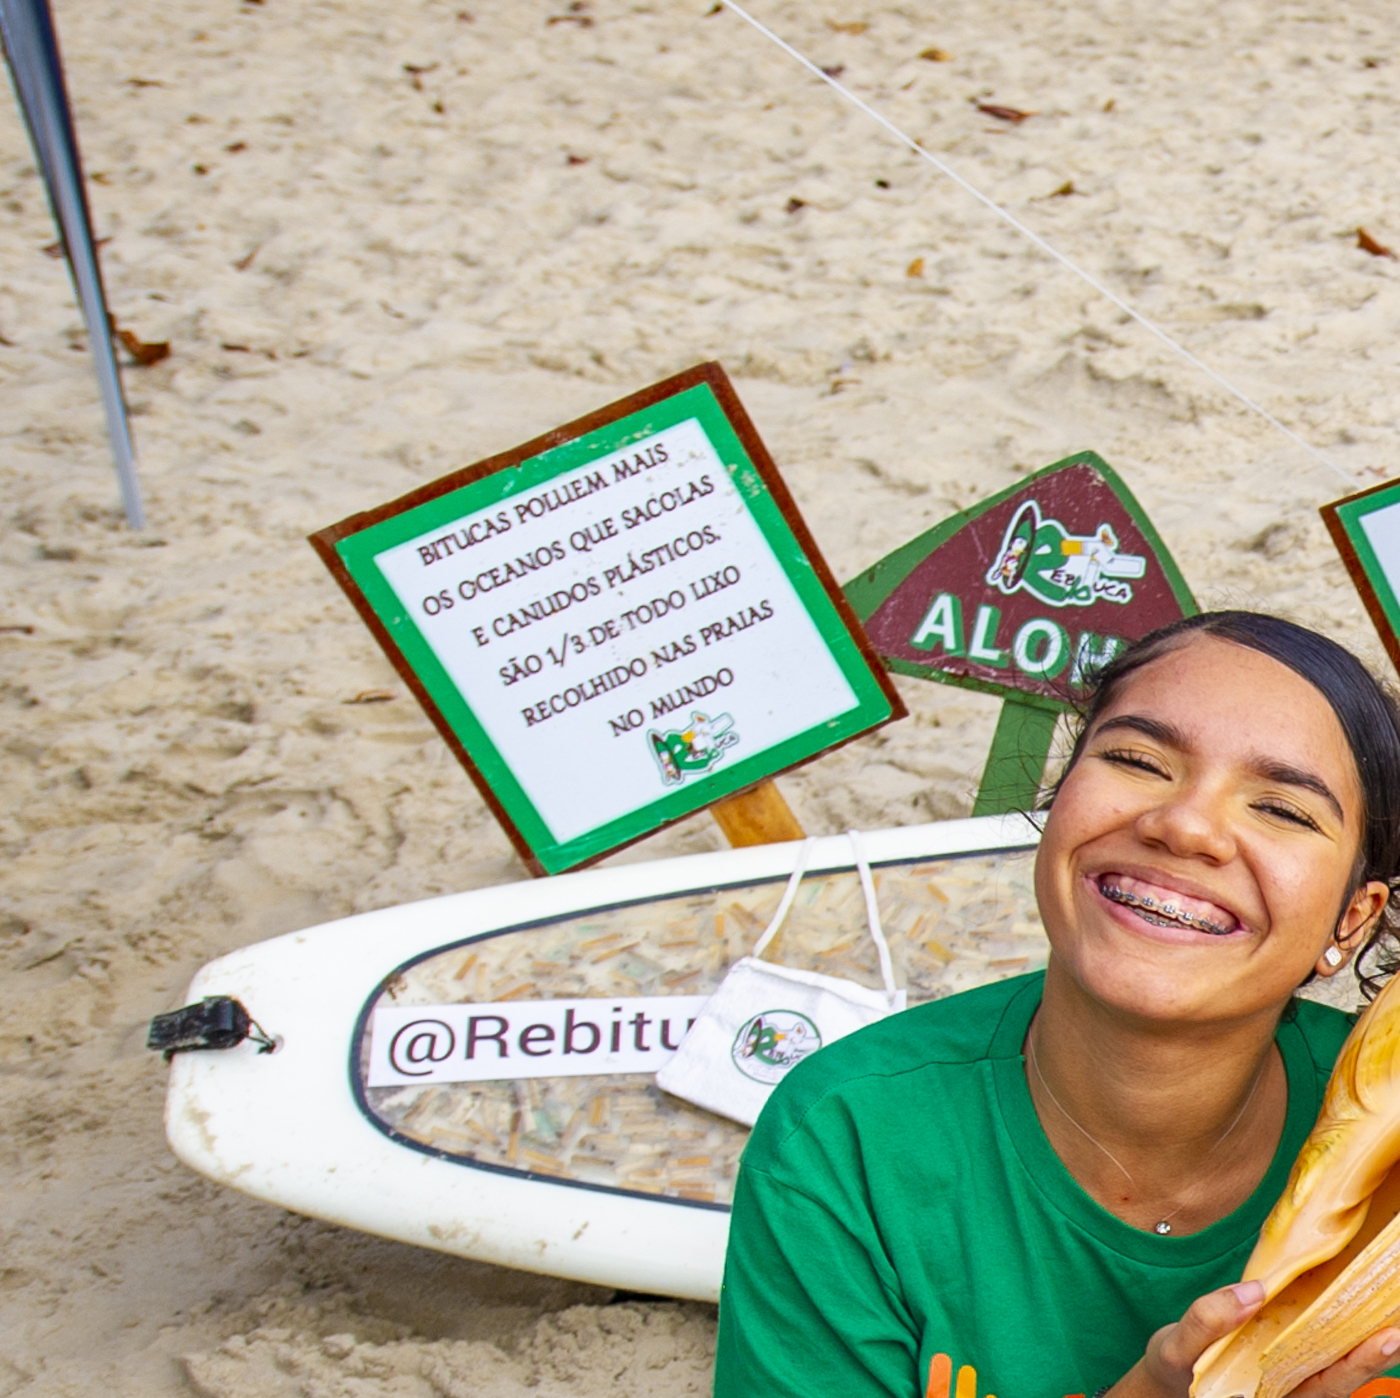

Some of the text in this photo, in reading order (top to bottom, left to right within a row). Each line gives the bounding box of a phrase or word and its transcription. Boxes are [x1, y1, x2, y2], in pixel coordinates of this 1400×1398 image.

[417, 443, 668, 566] BITUCAS POLUEM MAIS
[422, 474, 715, 617] OS OCEANOS QUE SACOLAS
[472, 626, 490, 647] E
[492, 576, 602, 640] CANUDOS
[499, 564, 741, 687] SÃO 1/3 DE TODO LIXO
[521, 599, 775, 728] RECOLHIDO NAS PRAIAS
[910, 592, 1126, 689] ALOH
[609, 667, 735, 738] NO MUNDO
[387, 1005, 698, 1078] @Rebitu
